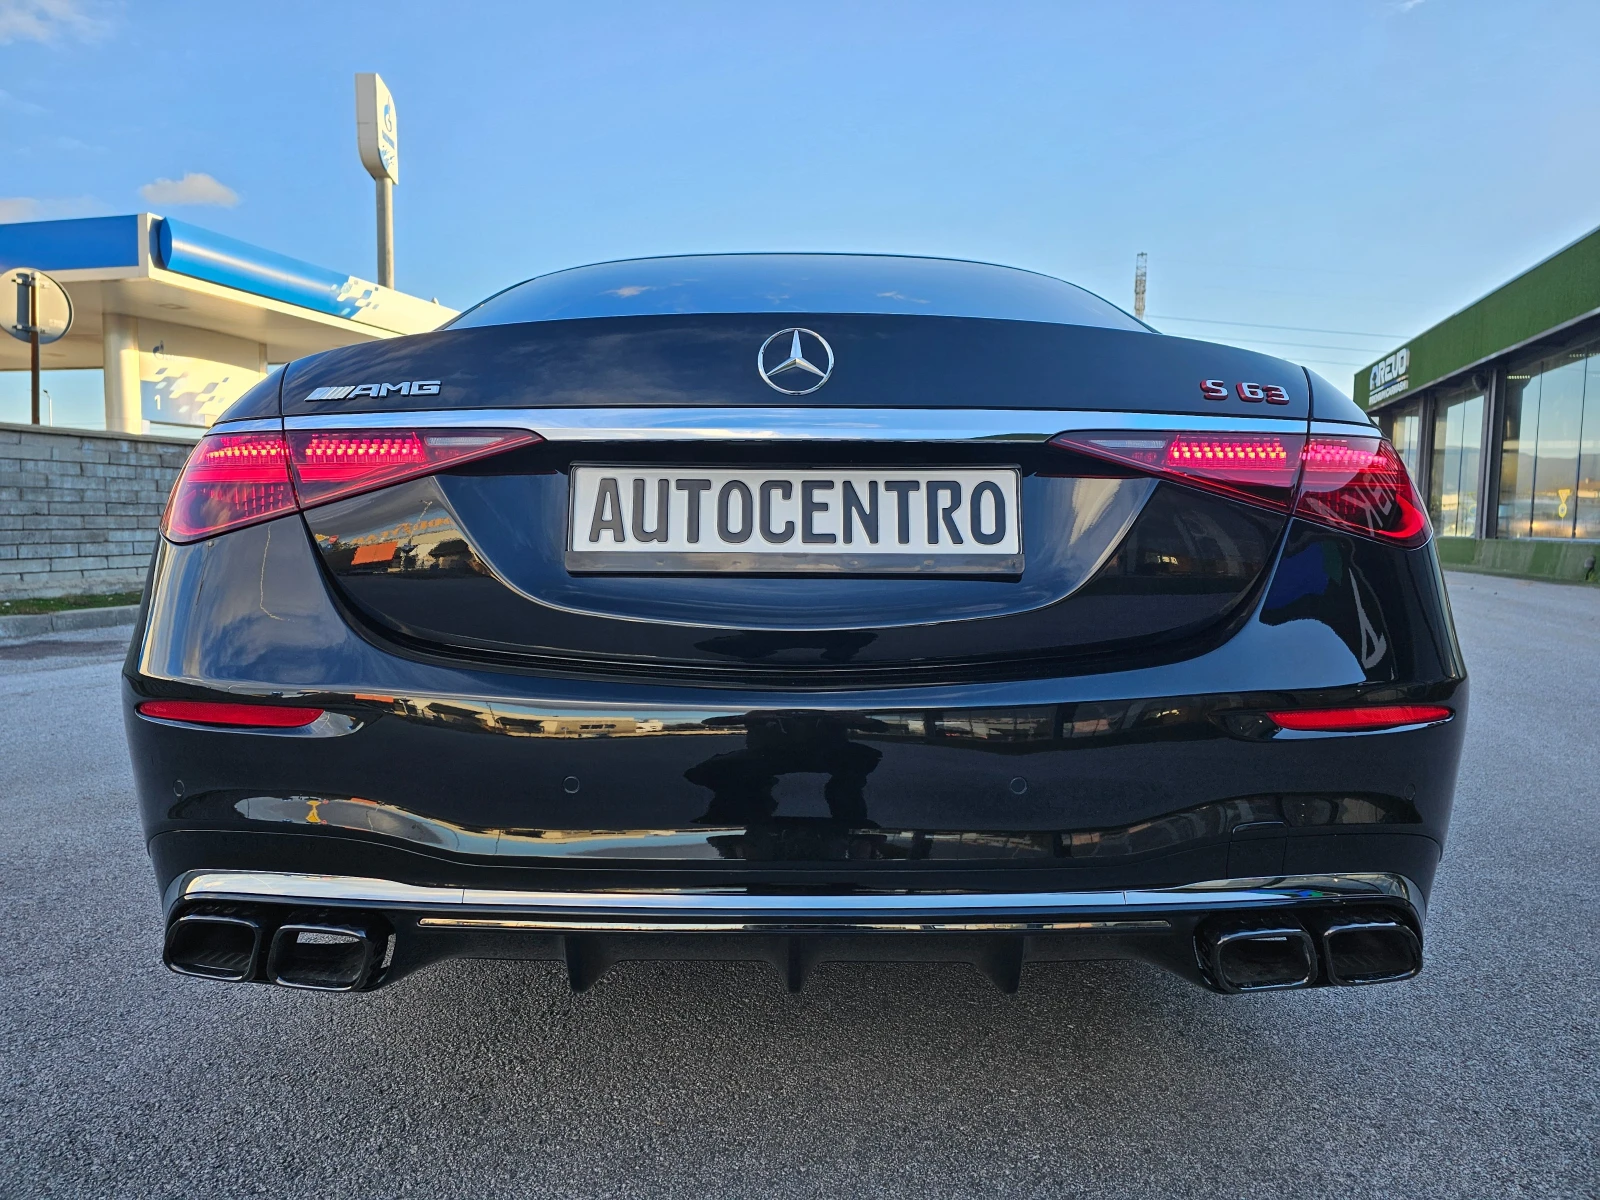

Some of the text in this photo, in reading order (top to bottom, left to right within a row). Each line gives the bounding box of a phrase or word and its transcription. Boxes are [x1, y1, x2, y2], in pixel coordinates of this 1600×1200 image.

[346, 380, 442, 399] AMG
[1200, 379, 1290, 405] S 63
[589, 478, 1007, 545] AUTOCENTRO
